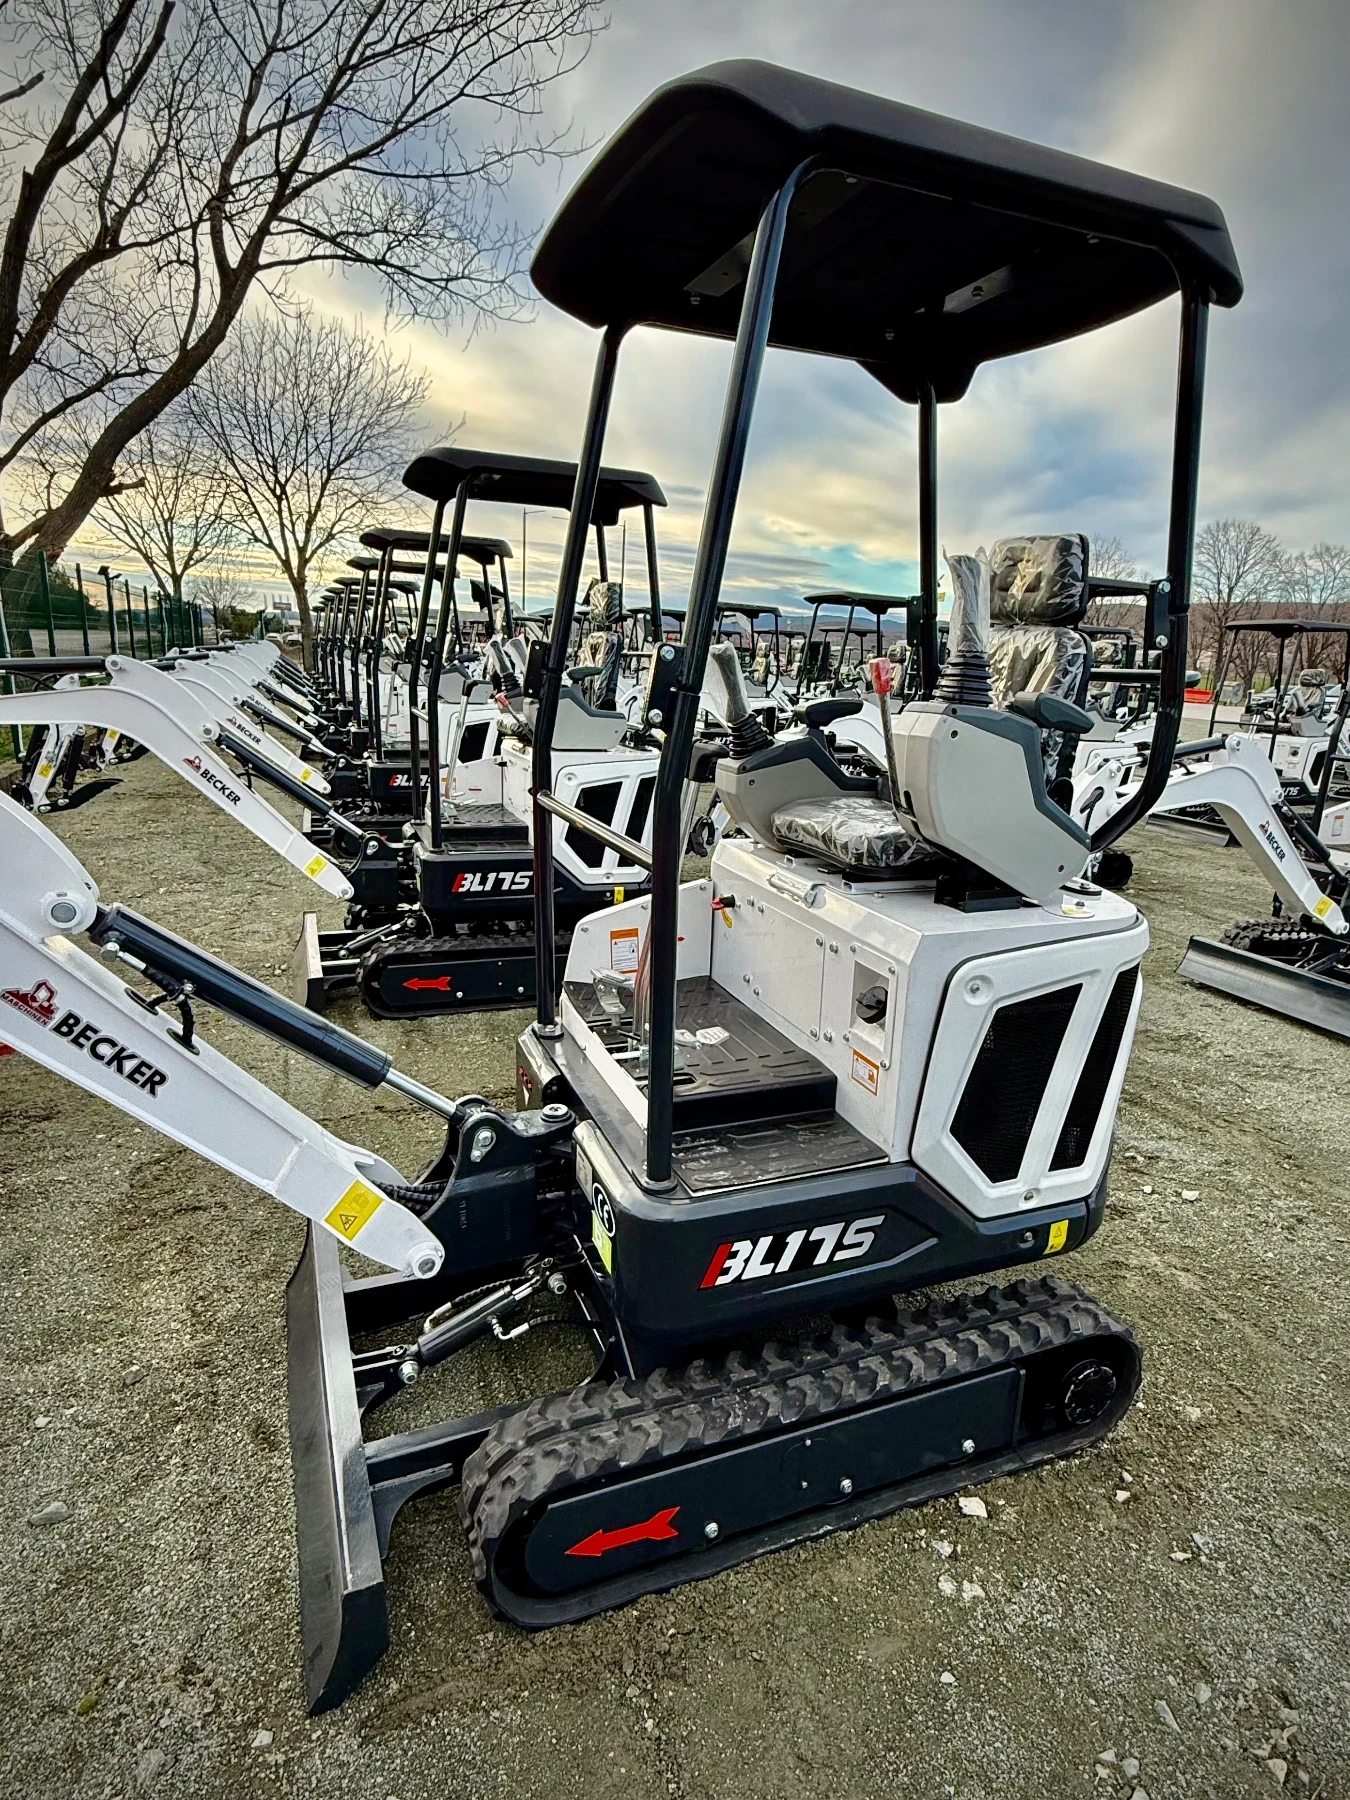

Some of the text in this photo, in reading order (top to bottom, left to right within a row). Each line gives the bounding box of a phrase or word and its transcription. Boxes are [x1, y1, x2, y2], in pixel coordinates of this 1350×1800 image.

[236, 724, 261, 745] BECKER
[200, 768, 241, 806] BECKER
[1266, 832, 1286, 862] BECKER
[452, 871, 534, 893] BL17S
[52, 1012, 167, 1096] BECKER
[597, 1193, 610, 1230] CE
[700, 1215, 886, 1289] BL17S
